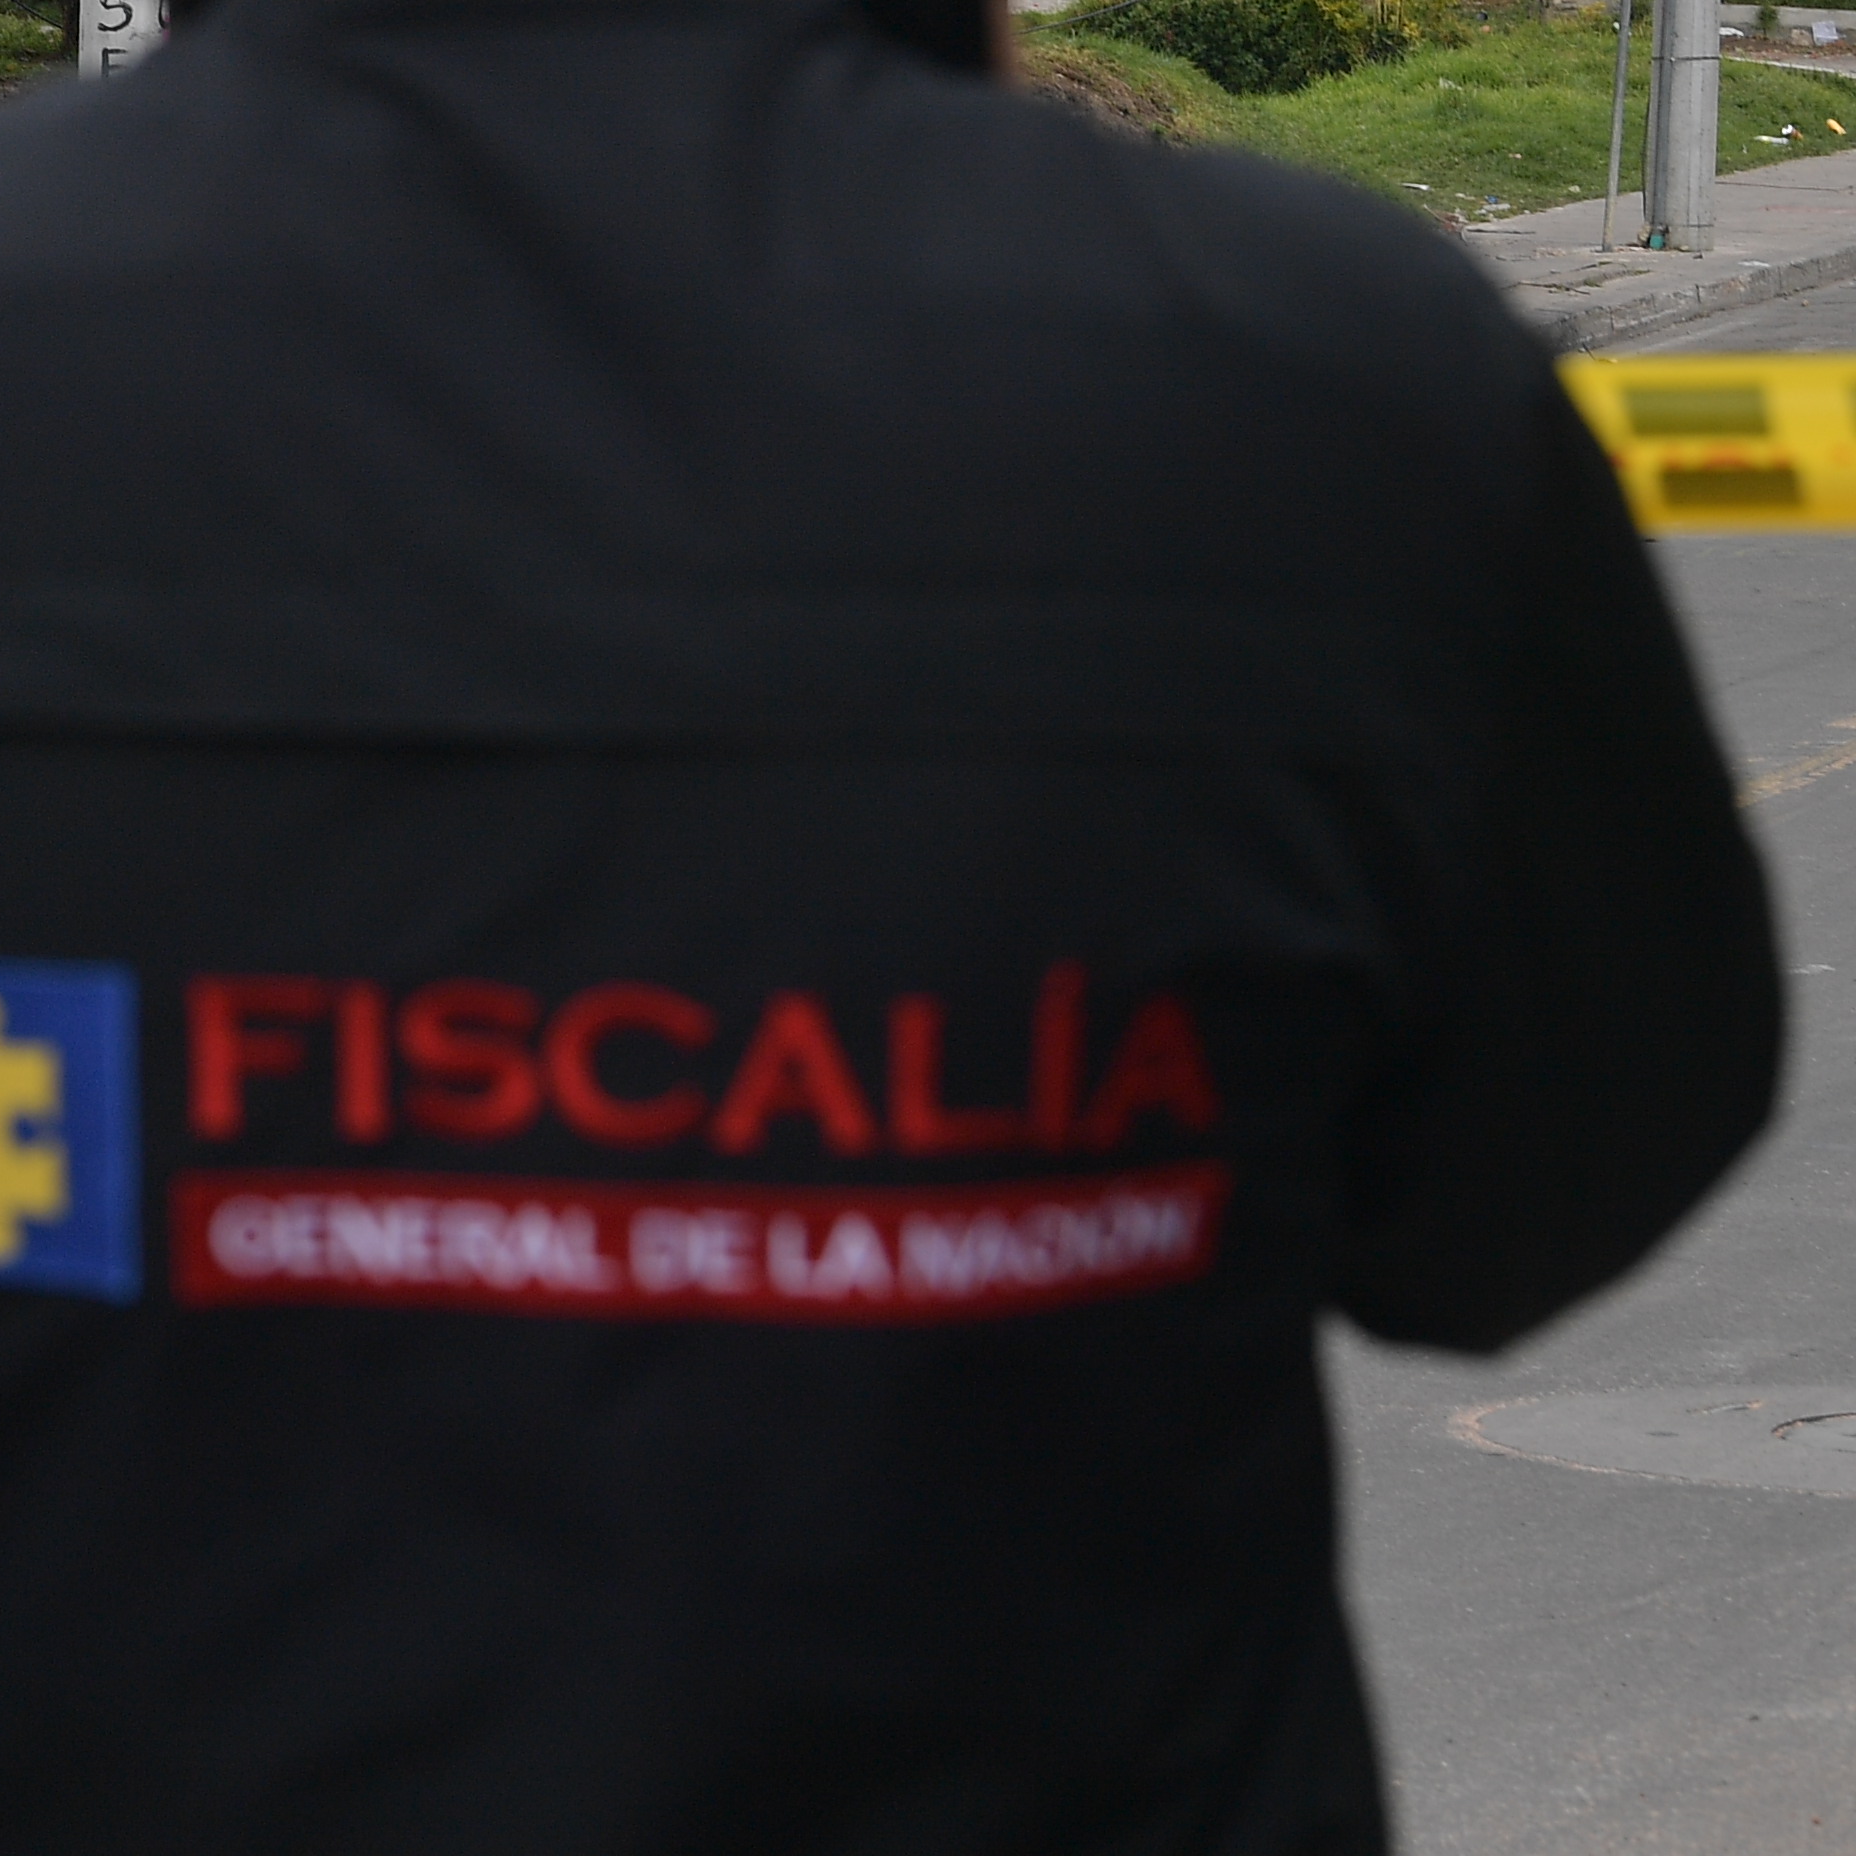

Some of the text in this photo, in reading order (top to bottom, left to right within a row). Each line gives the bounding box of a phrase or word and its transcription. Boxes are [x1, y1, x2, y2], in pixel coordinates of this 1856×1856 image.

[185, 961, 1223, 1156] FISCALÍA
[206, 1192, 618, 1294] GENERAL
[630, 1202, 755, 1297] DE
[764, 1204, 895, 1301] LA
